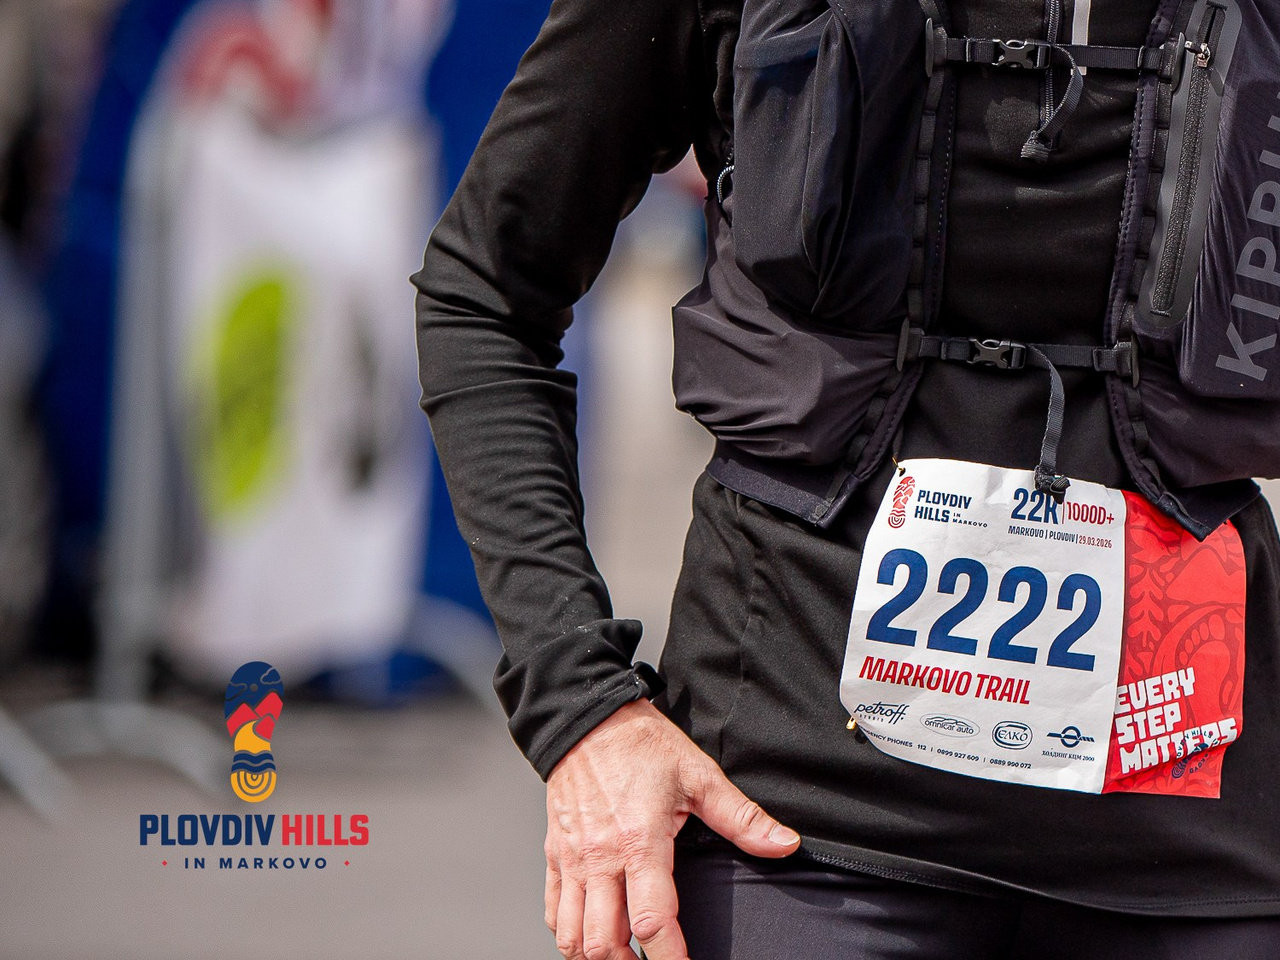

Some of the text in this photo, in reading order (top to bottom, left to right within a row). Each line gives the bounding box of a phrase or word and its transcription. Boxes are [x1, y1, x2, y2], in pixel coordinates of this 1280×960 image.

[914, 505, 950, 523] HILLS
[917, 489, 972, 509] PLOVDIV
[1010, 487, 1115, 525] 22K 1000D+
[952, 518, 988, 528] MARKOVO
[1008, 525, 1112, 548] MARKOVO PLOVDIV 29.03.2026
[865, 548, 1102, 672] 2222
[859, 656, 1031, 705] MARKOVO TRAIL
[1114, 667, 1195, 715] EVERY
[924, 719, 974, 735] omnicar auto
[1115, 702, 1181, 745] STEP
[887, 737, 913, 748] PHONES
[937, 748, 953, 757] 0899
[954, 751, 966, 759] 927
[989, 758, 1006, 766] 0889
[1119, 717, 1237, 774] MATTERS
